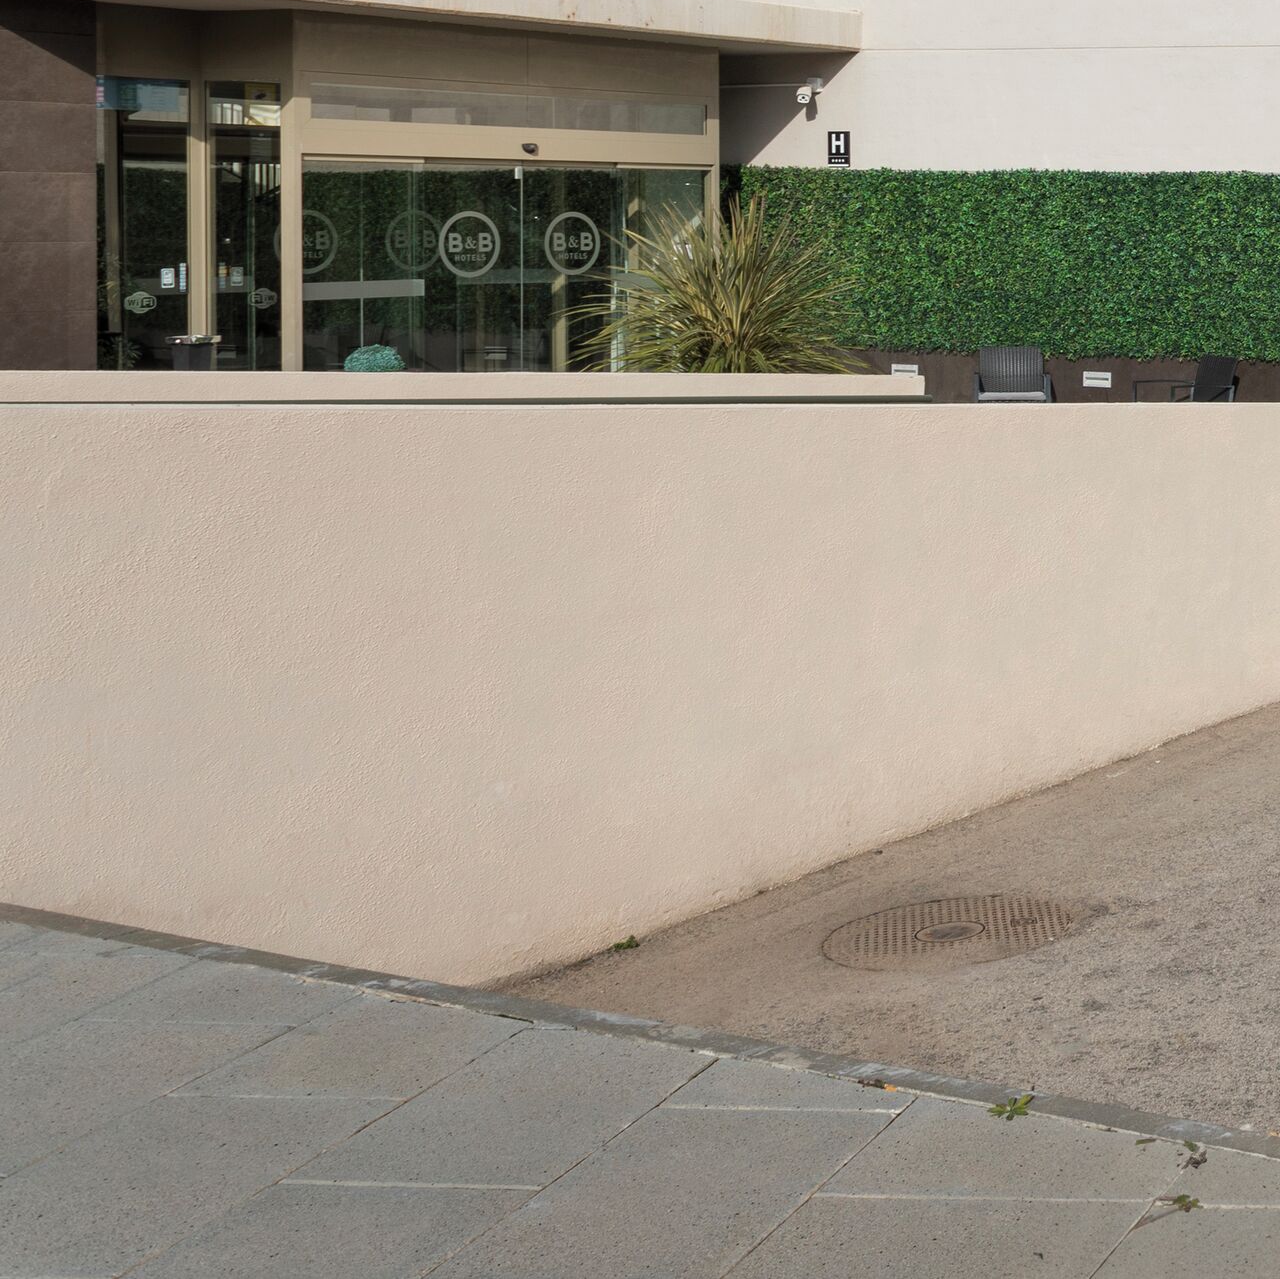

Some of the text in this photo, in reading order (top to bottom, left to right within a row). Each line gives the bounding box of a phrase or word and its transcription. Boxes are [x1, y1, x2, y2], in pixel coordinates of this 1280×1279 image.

[831, 133, 845, 154] H
[304, 231, 330, 250] &B
[448, 232, 493, 253] B&B
[553, 232, 594, 251] B&B
[454, 254, 487, 262] HOTELS
[558, 252, 588, 260] HOTELS
